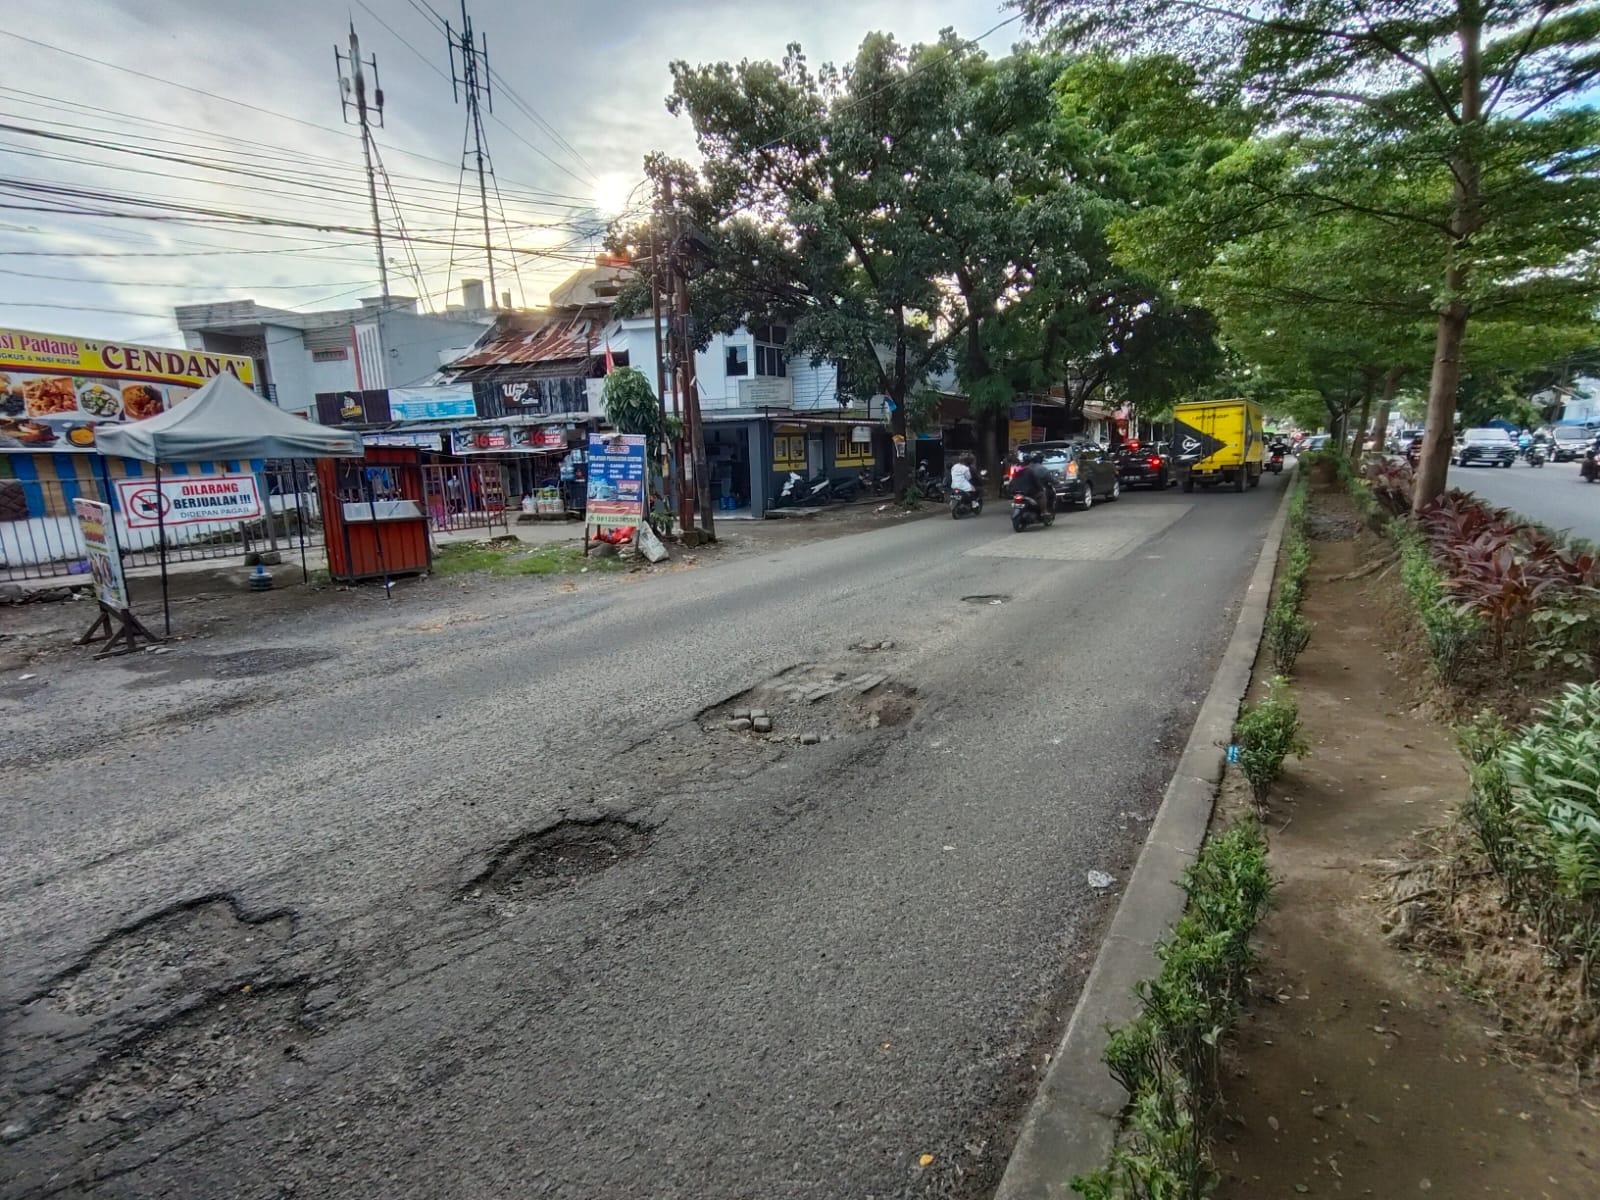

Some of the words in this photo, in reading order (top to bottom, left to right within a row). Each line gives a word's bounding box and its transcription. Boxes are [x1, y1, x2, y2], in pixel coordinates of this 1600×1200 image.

[0, 332, 15, 349] si
[19, 334, 80, 358] Padang
[182, 483, 239, 496] DILARANG
[173, 495, 238, 510] BERJUALAN
[239, 494, 252, 505] !!!
[180, 510, 219, 519] DIDEPAN
[221, 507, 250, 516] PAGAR
